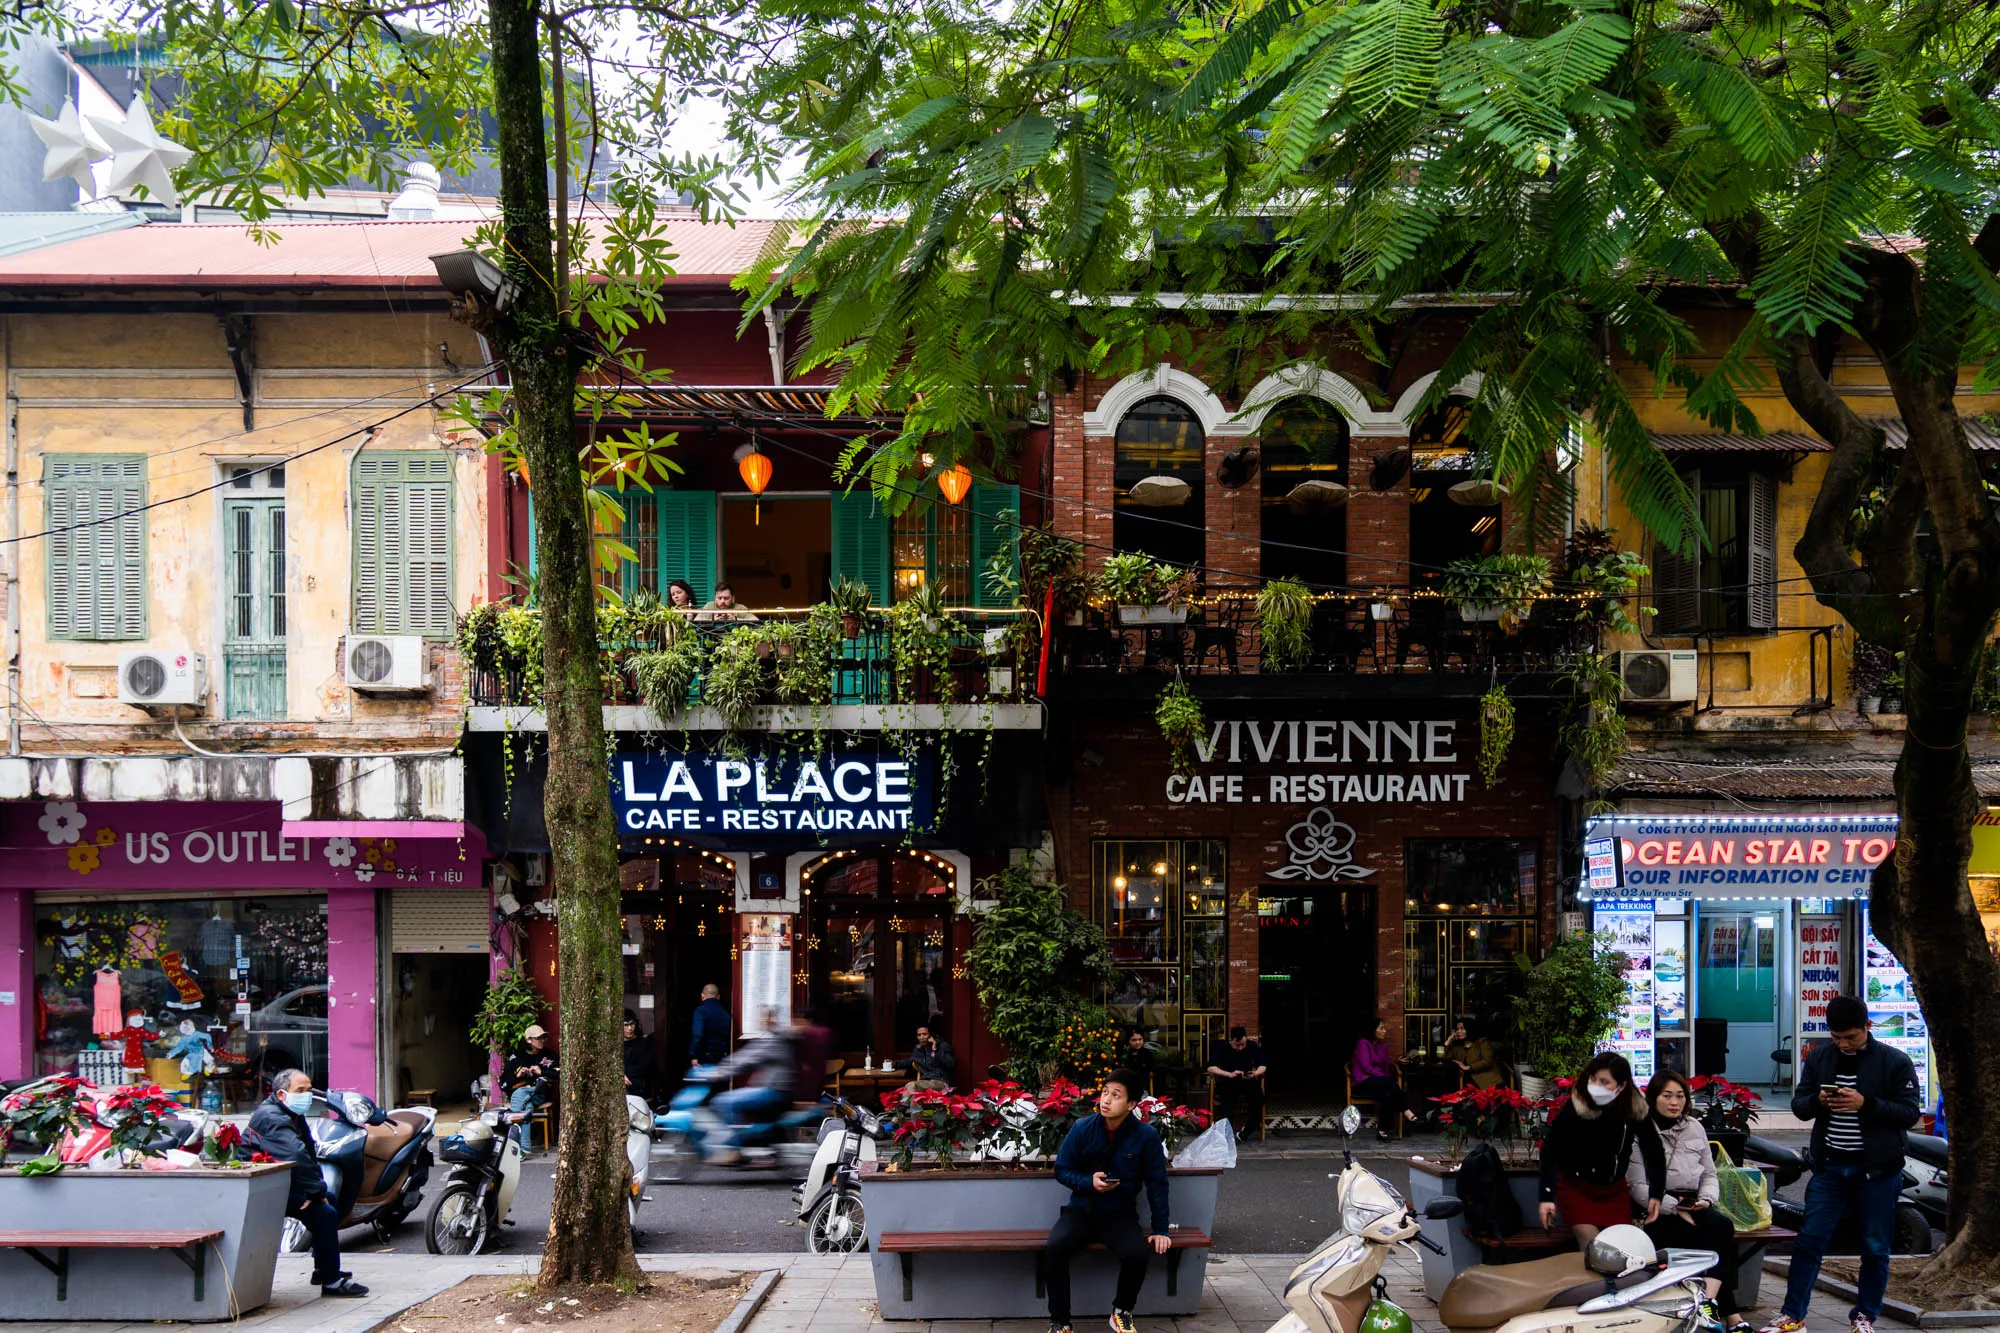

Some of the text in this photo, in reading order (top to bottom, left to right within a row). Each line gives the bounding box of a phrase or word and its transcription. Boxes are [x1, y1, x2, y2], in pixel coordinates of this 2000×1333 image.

[1189, 719, 1457, 762] VIVIENNE
[622, 760, 912, 802] LA PLACE
[1165, 774, 1243, 802] CAFE
[1269, 774, 1470, 803] RESTAURANT
[625, 808, 701, 830] CAFE
[722, 808, 913, 830] RESTAURANT
[1673, 825, 1688, 834] TY
[1742, 825, 1757, 833] DU
[1816, 824, 1838, 833] SAO
[125, 831, 170, 864] US
[1744, 838, 1831, 865] STAR
[765, 876, 772, 887] 6
[1625, 869, 1671, 884] OUR
[1678, 869, 1820, 884] INFORMATION
[1237, 890, 1252, 911] 4
[1620, 888, 1638, 897] 02
[1596, 902, 1652, 911] SAPA TREKKING
[1821, 922, 1840, 942] SẤY
[1802, 966, 1839, 986] NHUỘM
[1801, 989, 1820, 1001] SƠN
[1802, 1020, 1817, 1032] BÊN
